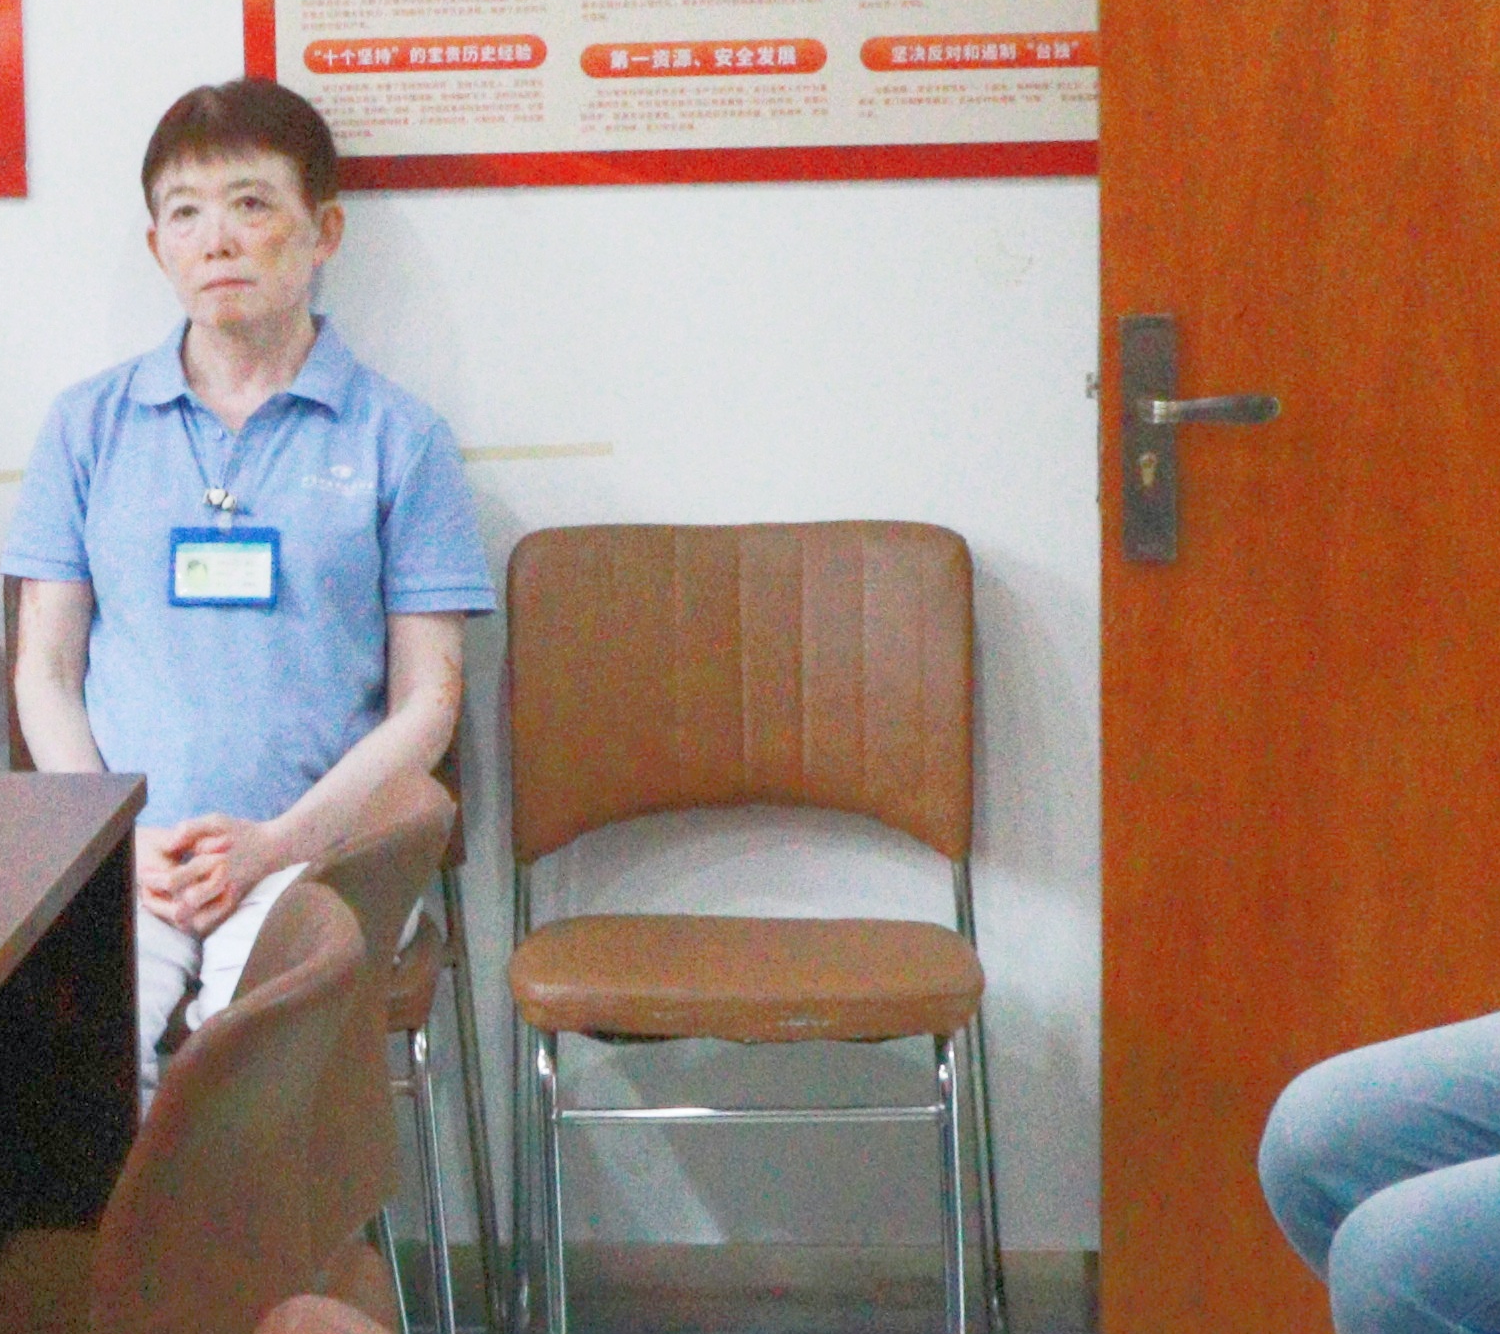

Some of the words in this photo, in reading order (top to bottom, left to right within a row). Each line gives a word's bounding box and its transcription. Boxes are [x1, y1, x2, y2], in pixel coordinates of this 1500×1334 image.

[610, 45, 798, 70] 第一资源、安全发展
